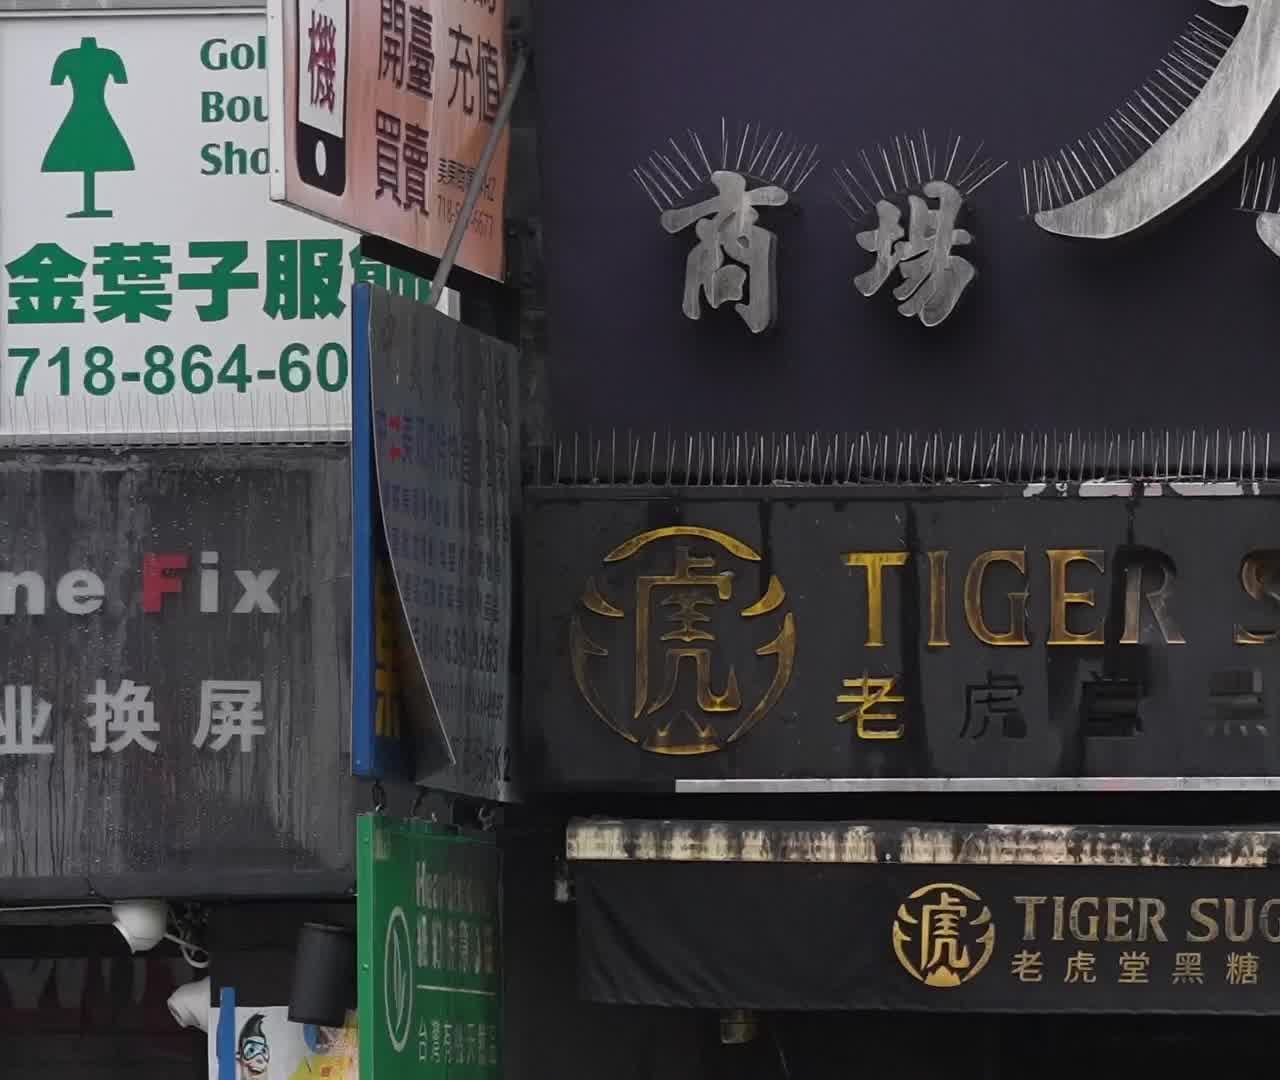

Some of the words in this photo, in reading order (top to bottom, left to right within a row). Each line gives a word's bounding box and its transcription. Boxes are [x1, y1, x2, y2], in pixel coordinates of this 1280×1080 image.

[7, 342, 349, 397] 718-864-60
[142, 551, 281, 614] Fix
[840, 548, 1187, 647] TIGER
[1014, 896, 1168, 943] TIGER
